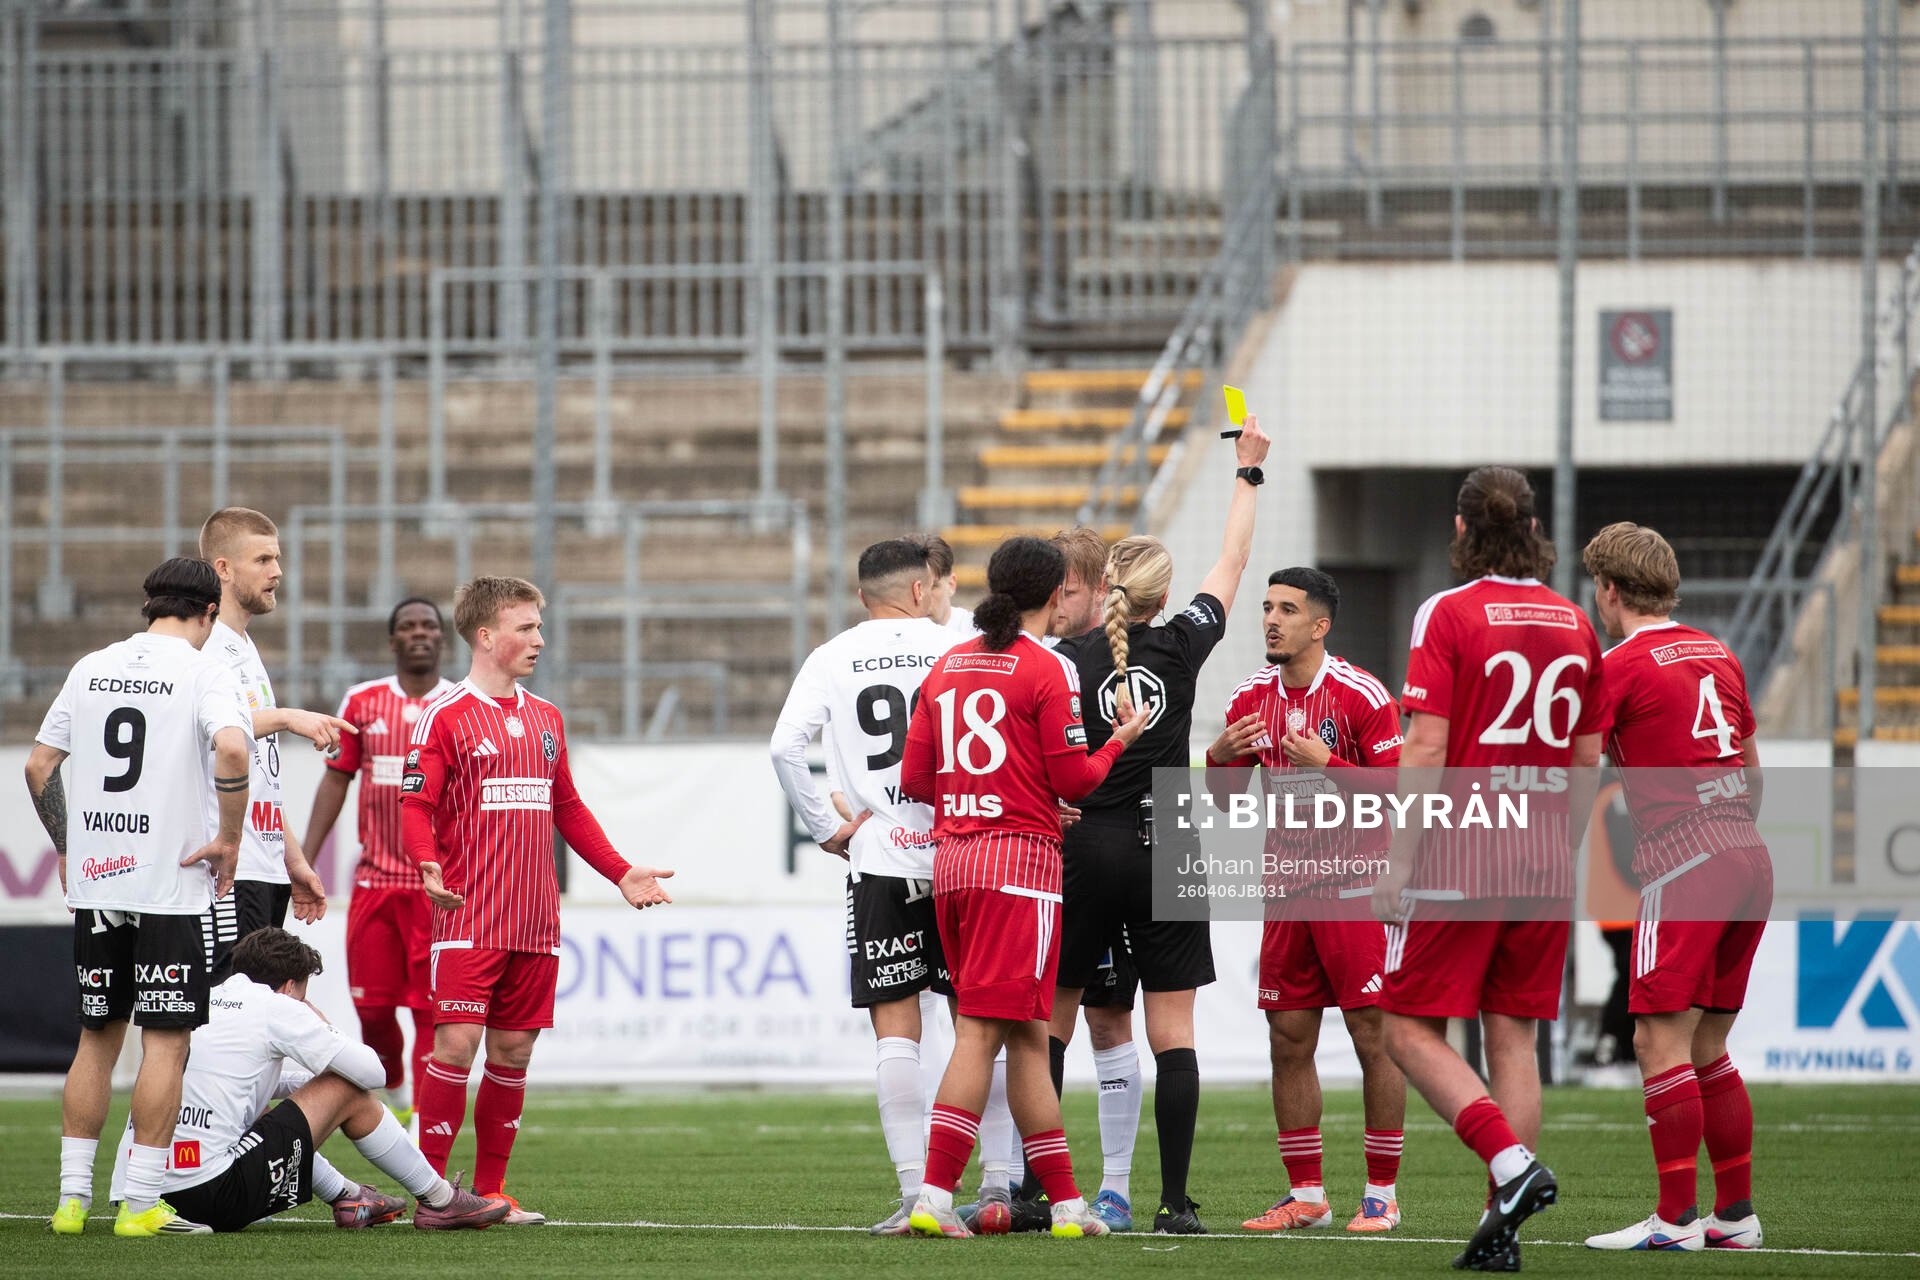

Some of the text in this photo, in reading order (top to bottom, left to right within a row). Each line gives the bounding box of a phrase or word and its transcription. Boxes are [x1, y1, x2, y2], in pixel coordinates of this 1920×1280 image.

[853, 654, 941, 673] ECDESIG
[962, 658, 1014, 669] Automotive
[88, 677, 174, 695] ECDESIGN
[1478, 650, 1588, 748] 26
[856, 684, 921, 771] 9
[1691, 673, 1742, 758] 4
[934, 687, 1007, 775] 18
[103, 707, 146, 792] 9
[1490, 765, 1568, 793] PULS
[942, 794, 1003, 818] PULS
[83, 811, 150, 834] YAKOUB
[82, 854, 138, 880] Radiator
[865, 931, 924, 960] EXACT
[868, 964, 928, 988] WELLNESS
[876, 957, 922, 977] NORDIC
[139, 991, 184, 1001] NORDIC
